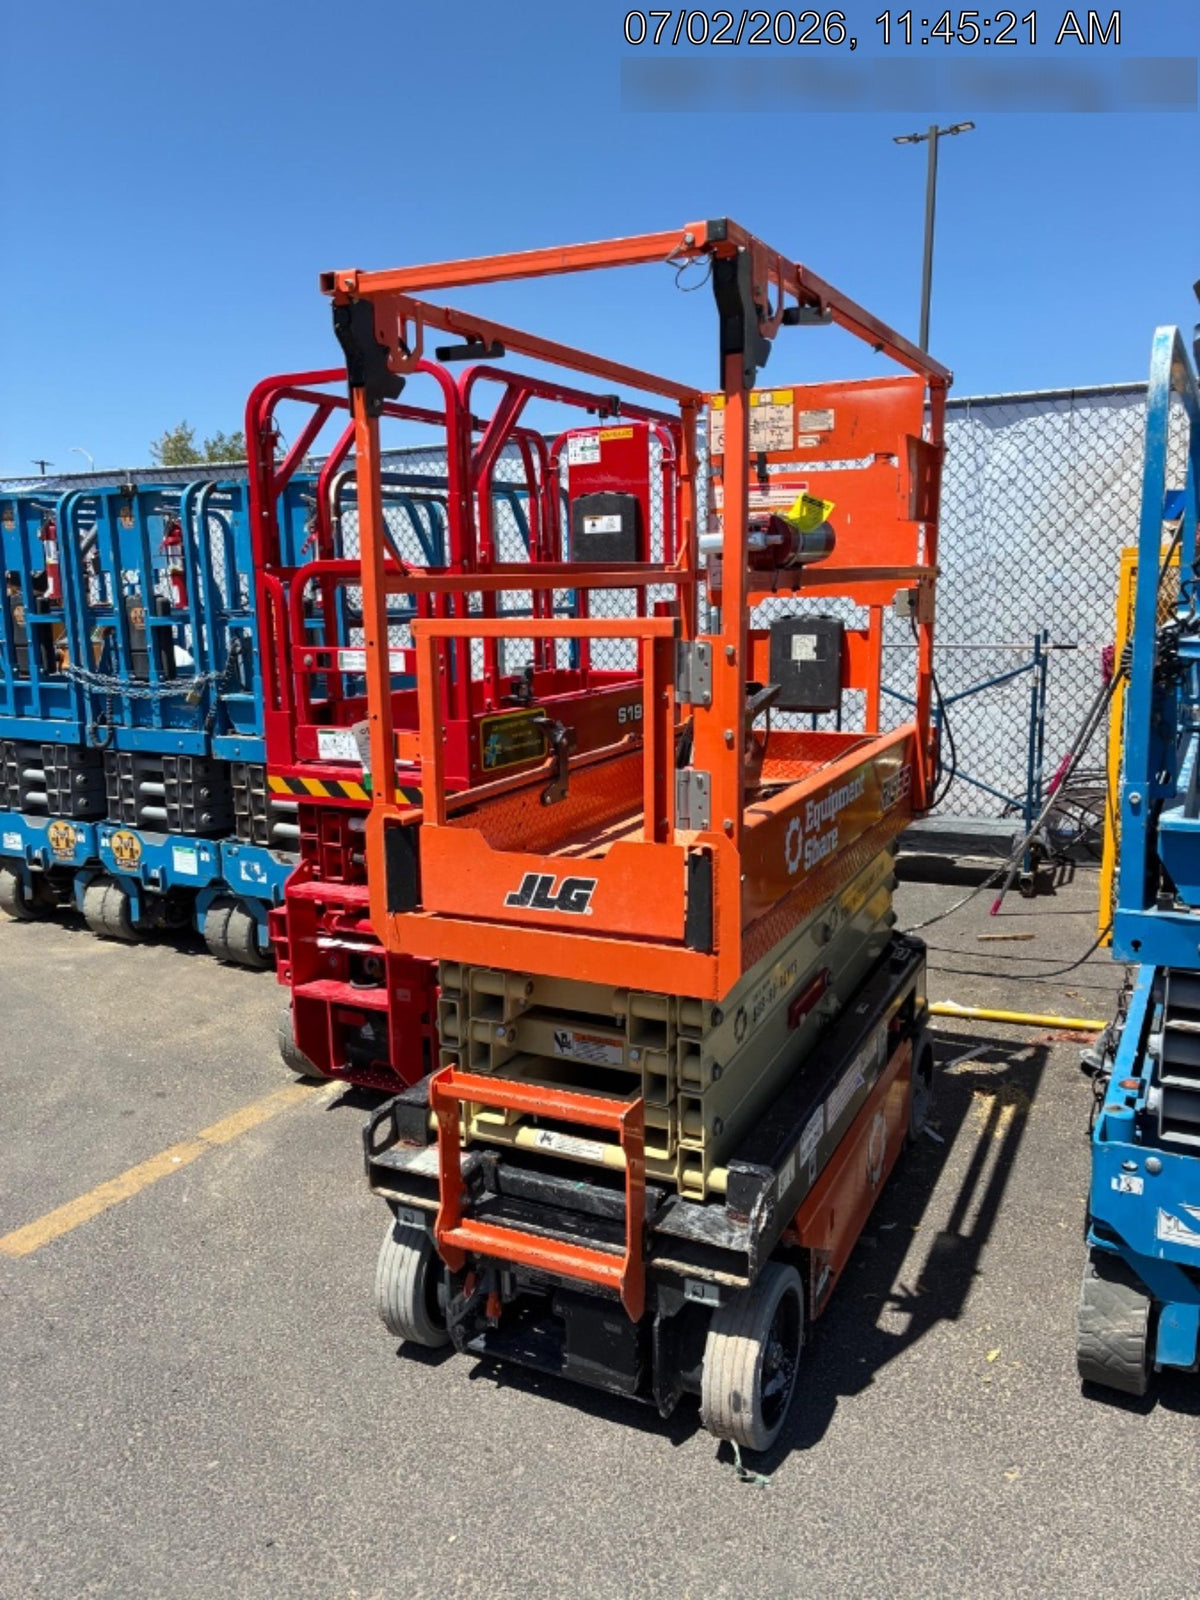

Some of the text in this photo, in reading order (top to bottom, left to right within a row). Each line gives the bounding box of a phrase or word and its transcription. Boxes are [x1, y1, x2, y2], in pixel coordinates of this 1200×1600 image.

[805, 774, 866, 833] Equipment
[803, 827, 839, 871] Share
[503, 871, 598, 915] JLG
